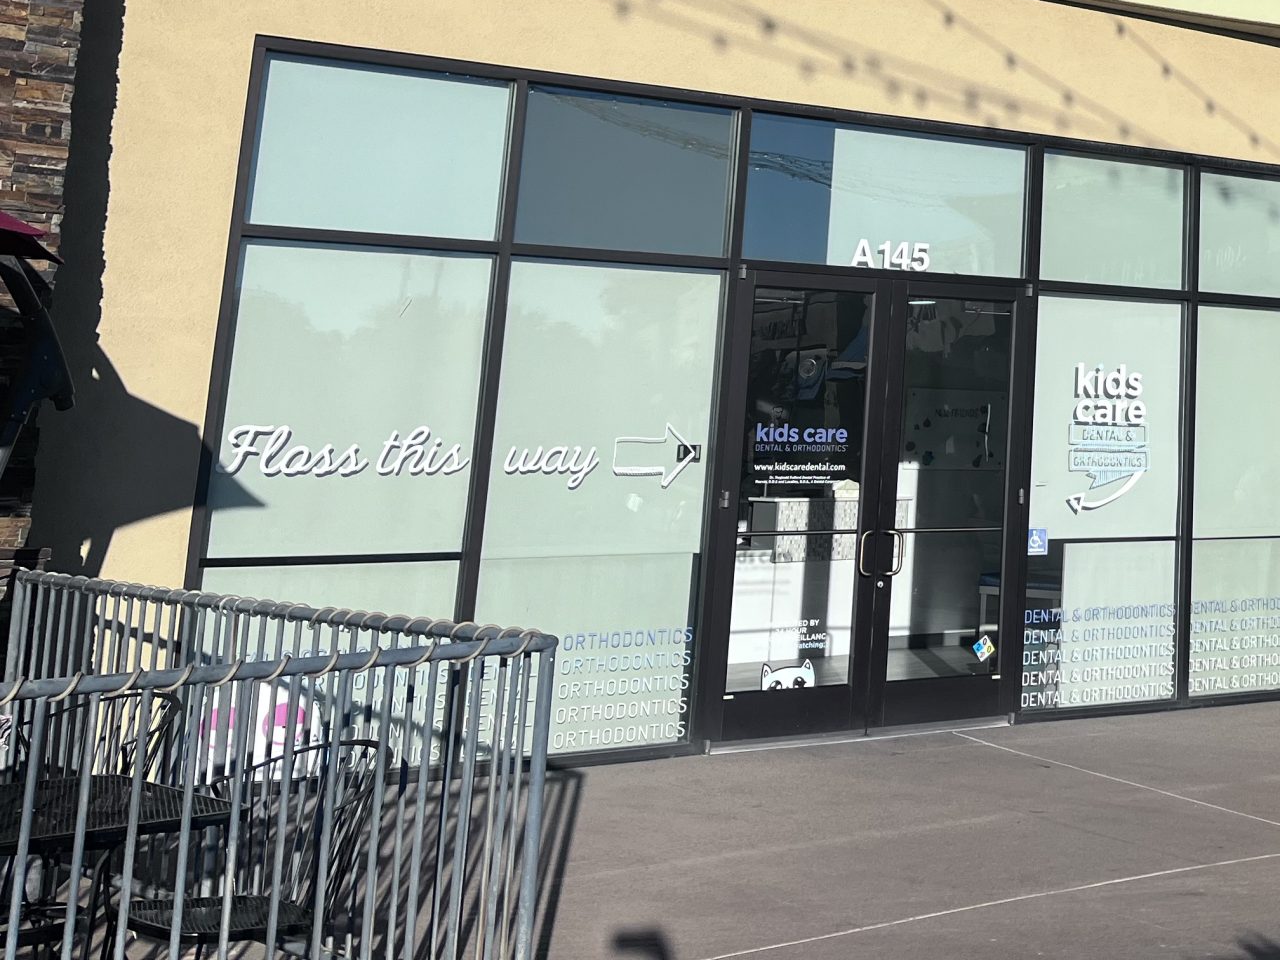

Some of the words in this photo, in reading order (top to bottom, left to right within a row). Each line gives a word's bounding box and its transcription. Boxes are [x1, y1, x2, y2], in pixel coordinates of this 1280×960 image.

[851, 239, 930, 271] A145
[1077, 362, 1143, 397] kids
[1075, 399, 1147, 424] care
[756, 423, 799, 442] kids
[803, 427, 848, 443] care
[1083, 428, 1122, 441] DENTAL
[226, 424, 368, 476] Floss
[376, 425, 471, 476] this
[503, 443, 600, 489] way
[755, 444, 783, 452] DENTAL
[785, 444, 791, 452] &
[754, 462, 846, 471] www.kidscaredental.com
[1025, 607, 1069, 623] DENTAL
[1072, 607, 1082, 621] &
[1084, 603, 1175, 621] ORTHODONTICS
[563, 627, 693, 651] ORTHODONTICS
[1024, 628, 1068, 644] DENTAL
[1084, 623, 1175, 641] ORTHODONTICS
[561, 651, 691, 675] ORTHODONTICS
[1023, 648, 1069, 665] DENTAL
[1083, 642, 1174, 661] ORTHODONTICS
[1022, 669, 1069, 686] DENTAL
[1083, 662, 1174, 681] ORTHODONTICS
[558, 674, 689, 699] ORTHODONTICS
[1021, 690, 1068, 707] DENTAL
[1083, 682, 1174, 702] ORTHODONTICS
[556, 697, 687, 724] ORTHODONTICS
[553, 722, 686, 749] ORTHODONTICS
